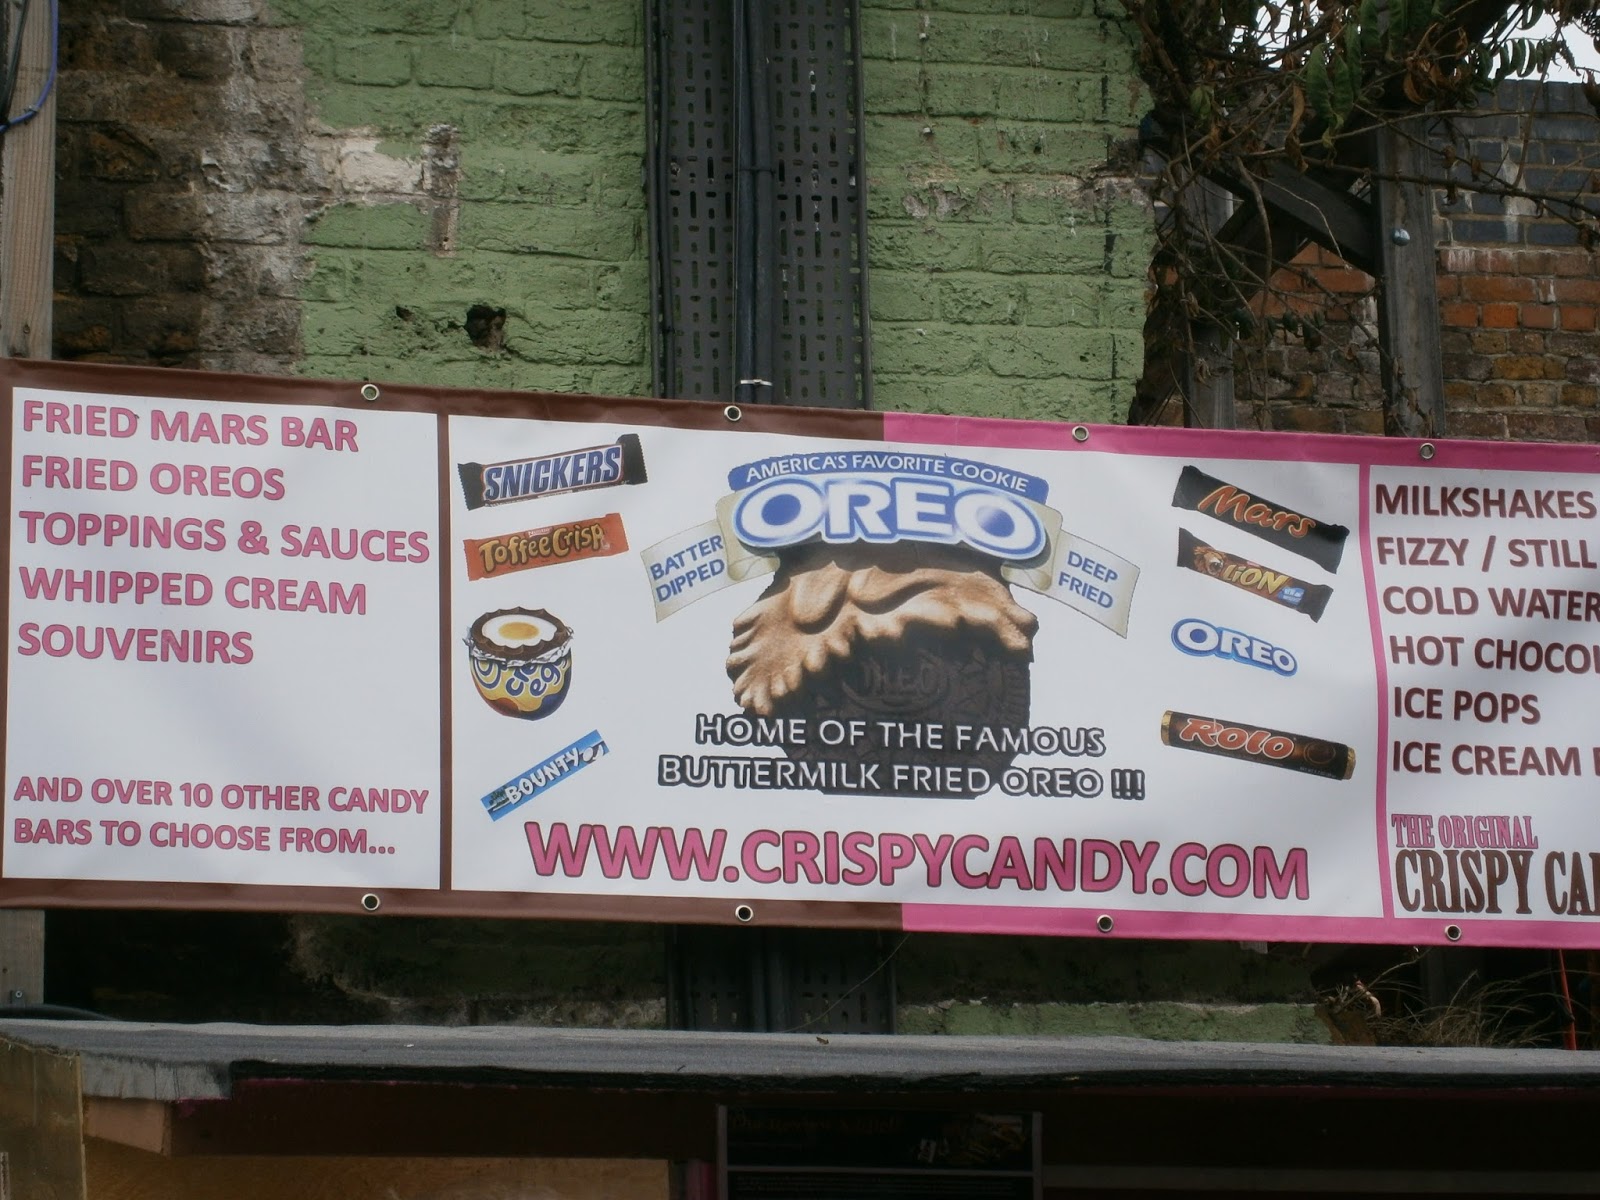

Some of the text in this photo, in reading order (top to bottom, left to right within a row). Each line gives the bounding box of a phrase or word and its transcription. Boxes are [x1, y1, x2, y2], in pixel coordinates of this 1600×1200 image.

[23, 400, 359, 452] FRIED MARS BAR
[22, 454, 285, 500] FRIED OREOS
[485, 446, 621, 502] SNICKERS
[746, 453, 1030, 494] AMERICA'S FAVORITE COOKIE
[735, 476, 1048, 560] OREO
[1198, 484, 1316, 538] Mars
[1375, 483, 1598, 519] MILKSHAKES
[19, 510, 430, 563] TOPPINGS & SAUCES
[649, 534, 725, 581] BATTER
[1377, 536, 1469, 566] FIZZY
[1507, 538, 1598, 569] STILL
[656, 558, 725, 603] DIPPED
[1066, 550, 1119, 583] DEEP
[19, 566, 367, 615] WHIPPED CREAM
[1058, 572, 1114, 610] FRIED
[1383, 585, 1600, 622] COLD WATER
[17, 622, 254, 664] SOUVENIRS
[1173, 619, 1298, 676] OREO
[1389, 635, 1465, 667] HOT
[1394, 686, 1541, 725] ICE POPS
[698, 713, 1106, 757] HOME OF THE FAMOUS
[505, 747, 580, 806] BOUNTY
[660, 756, 882, 791] BUTTERMILK
[892, 762, 991, 794] FRIED
[1001, 767, 1103, 798] OREO
[1393, 740, 1442, 774] ICE
[1452, 743, 1582, 776] CREAM
[14, 776, 429, 814] AND OVER 10 OTHER CANDY
[14, 818, 92, 845] BARS
[100, 819, 141, 846] TO
[149, 822, 270, 851] CHOOSE
[1391, 813, 1539, 850] THE ORIGINAL
[523, 820, 1311, 901] WWW.CRISPYCANDY.COM
[1395, 849, 1534, 914] CRISPY
